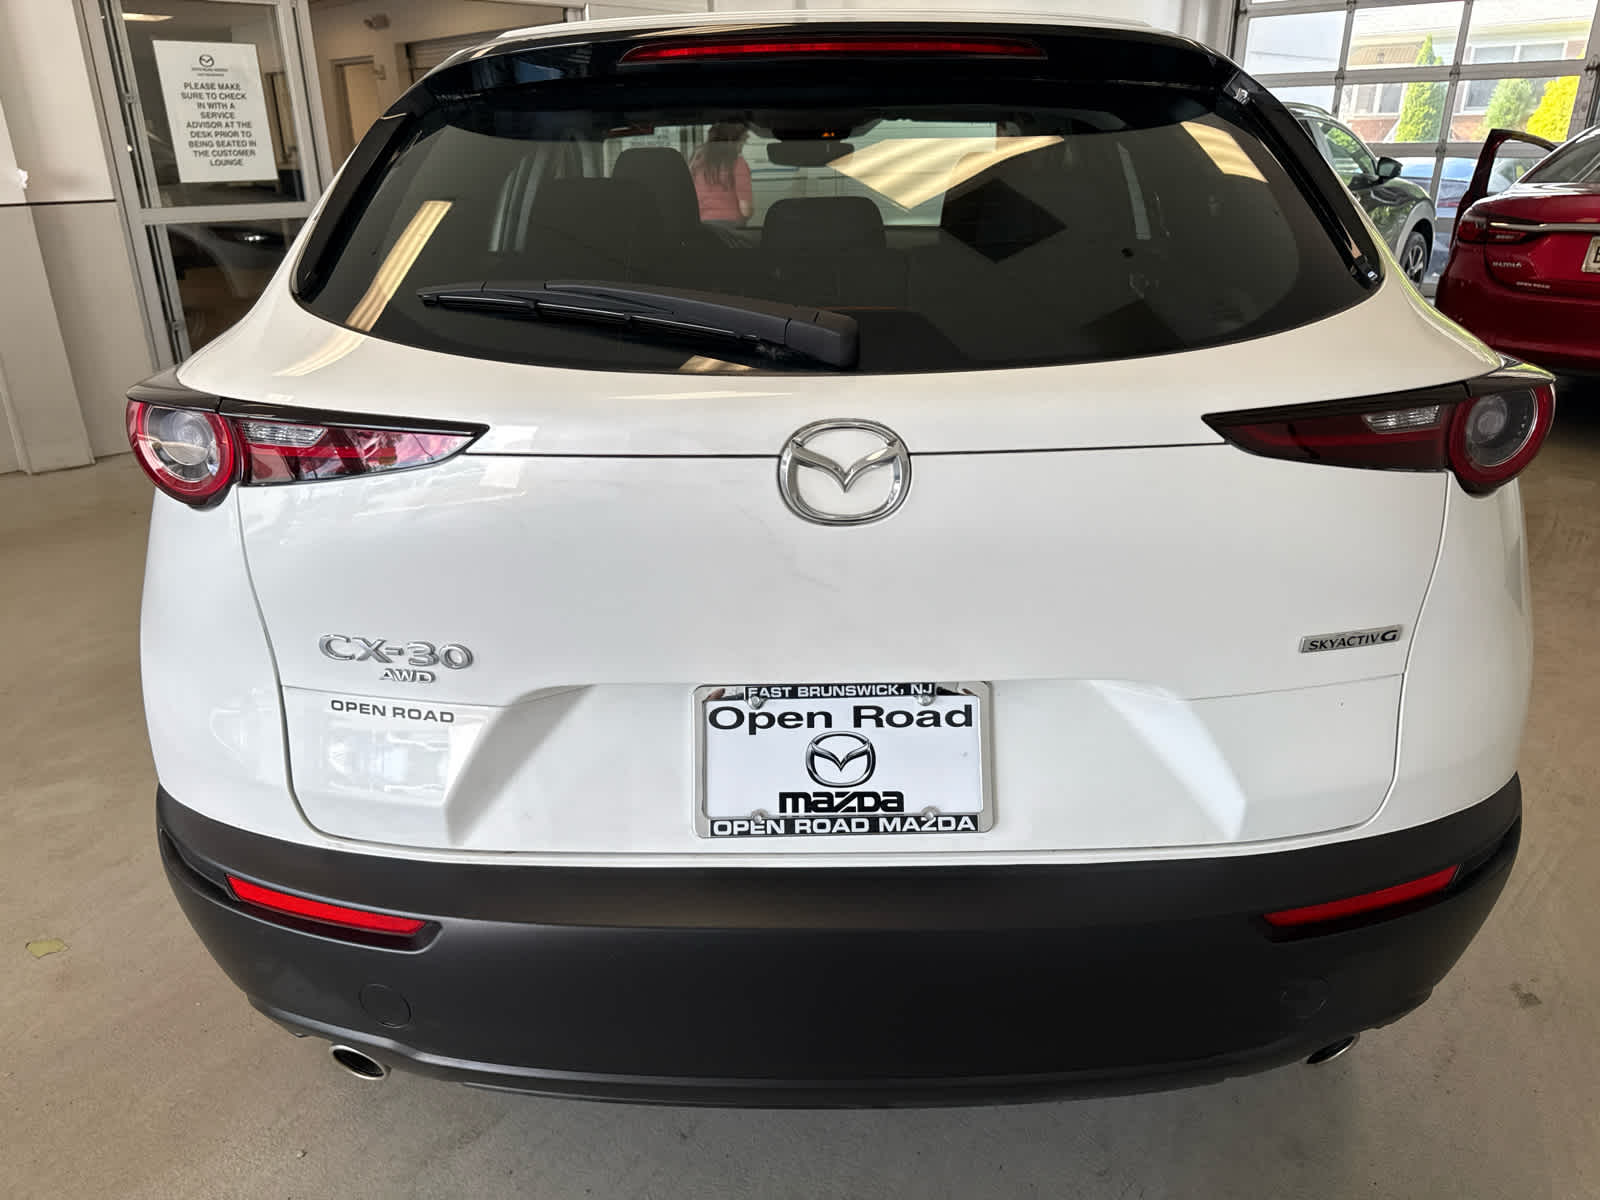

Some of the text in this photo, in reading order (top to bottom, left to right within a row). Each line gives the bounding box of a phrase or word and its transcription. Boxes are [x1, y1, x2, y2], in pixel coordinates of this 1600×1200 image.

[184, 82, 240, 90] PLEASE MAKE
[181, 92, 247, 100] SURE TO CHECK
[197, 102, 205, 110] IN
[206, 102, 228, 110] WITH
[200, 111, 235, 119] SERVICE
[186, 121, 252, 129] ADVISOR AT THE
[188, 140, 257, 148] BEING SEATED IN
[210, 159, 243, 167] LOUNGE
[319, 634, 474, 670] CX-30
[380, 668, 436, 684] AWD
[800, 684, 905, 698] BRUNSWICK,
[911, 683, 933, 696] NJ
[331, 700, 455, 723] OPEN ROAD
[708, 704, 973, 735] Open Road
[713, 816, 977, 836] OPEN ROAD MAZDA
